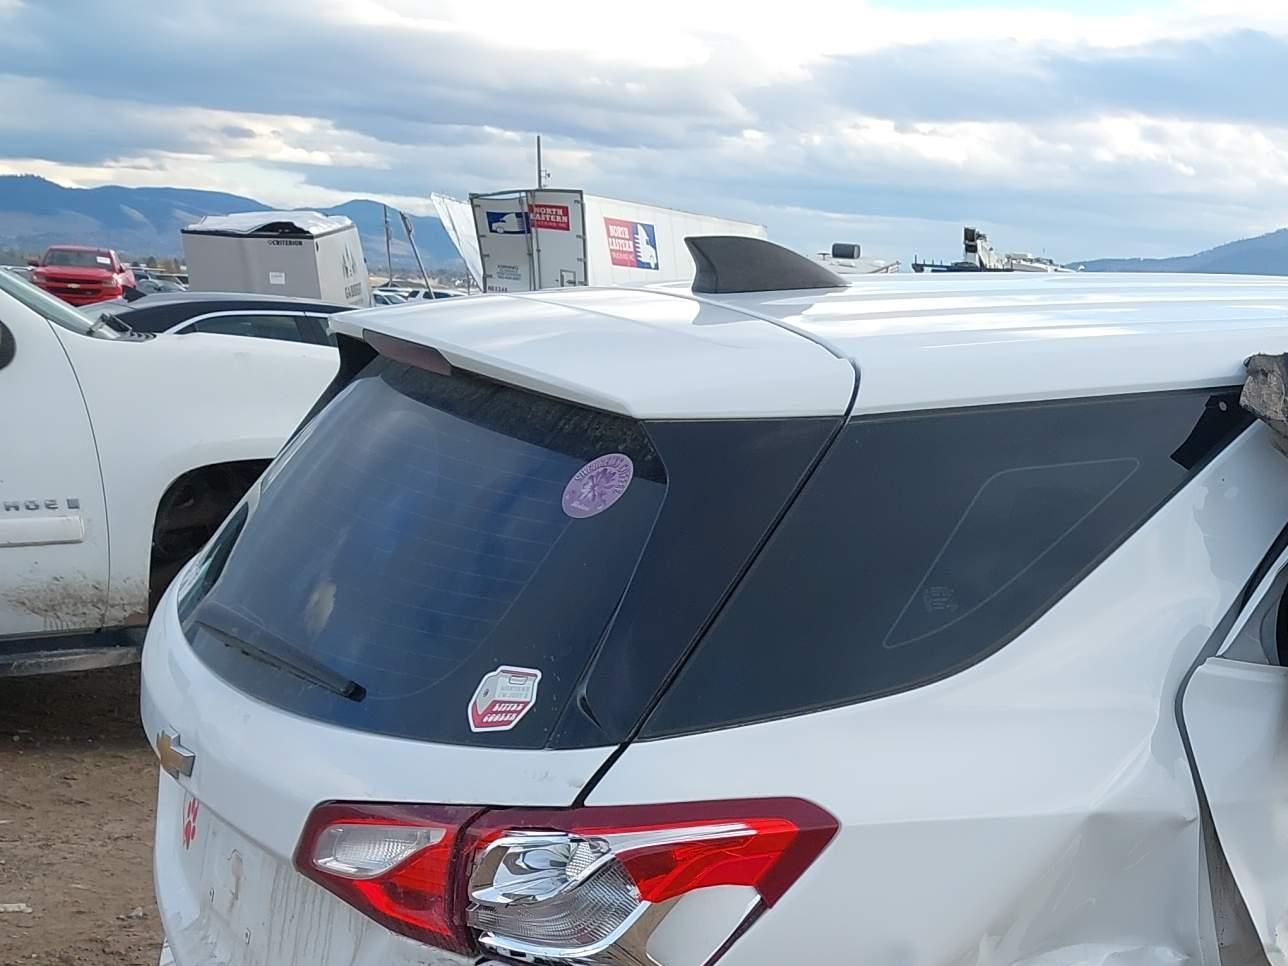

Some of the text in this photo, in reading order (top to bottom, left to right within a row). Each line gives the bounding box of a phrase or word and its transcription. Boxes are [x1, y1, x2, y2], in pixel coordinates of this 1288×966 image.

[533, 206, 563, 215] NORTH
[530, 213, 568, 223] EASTERN
[608, 224, 630, 239] NORTH
[608, 238, 634, 251] EASTERN
[3, 499, 59, 512] HOE
